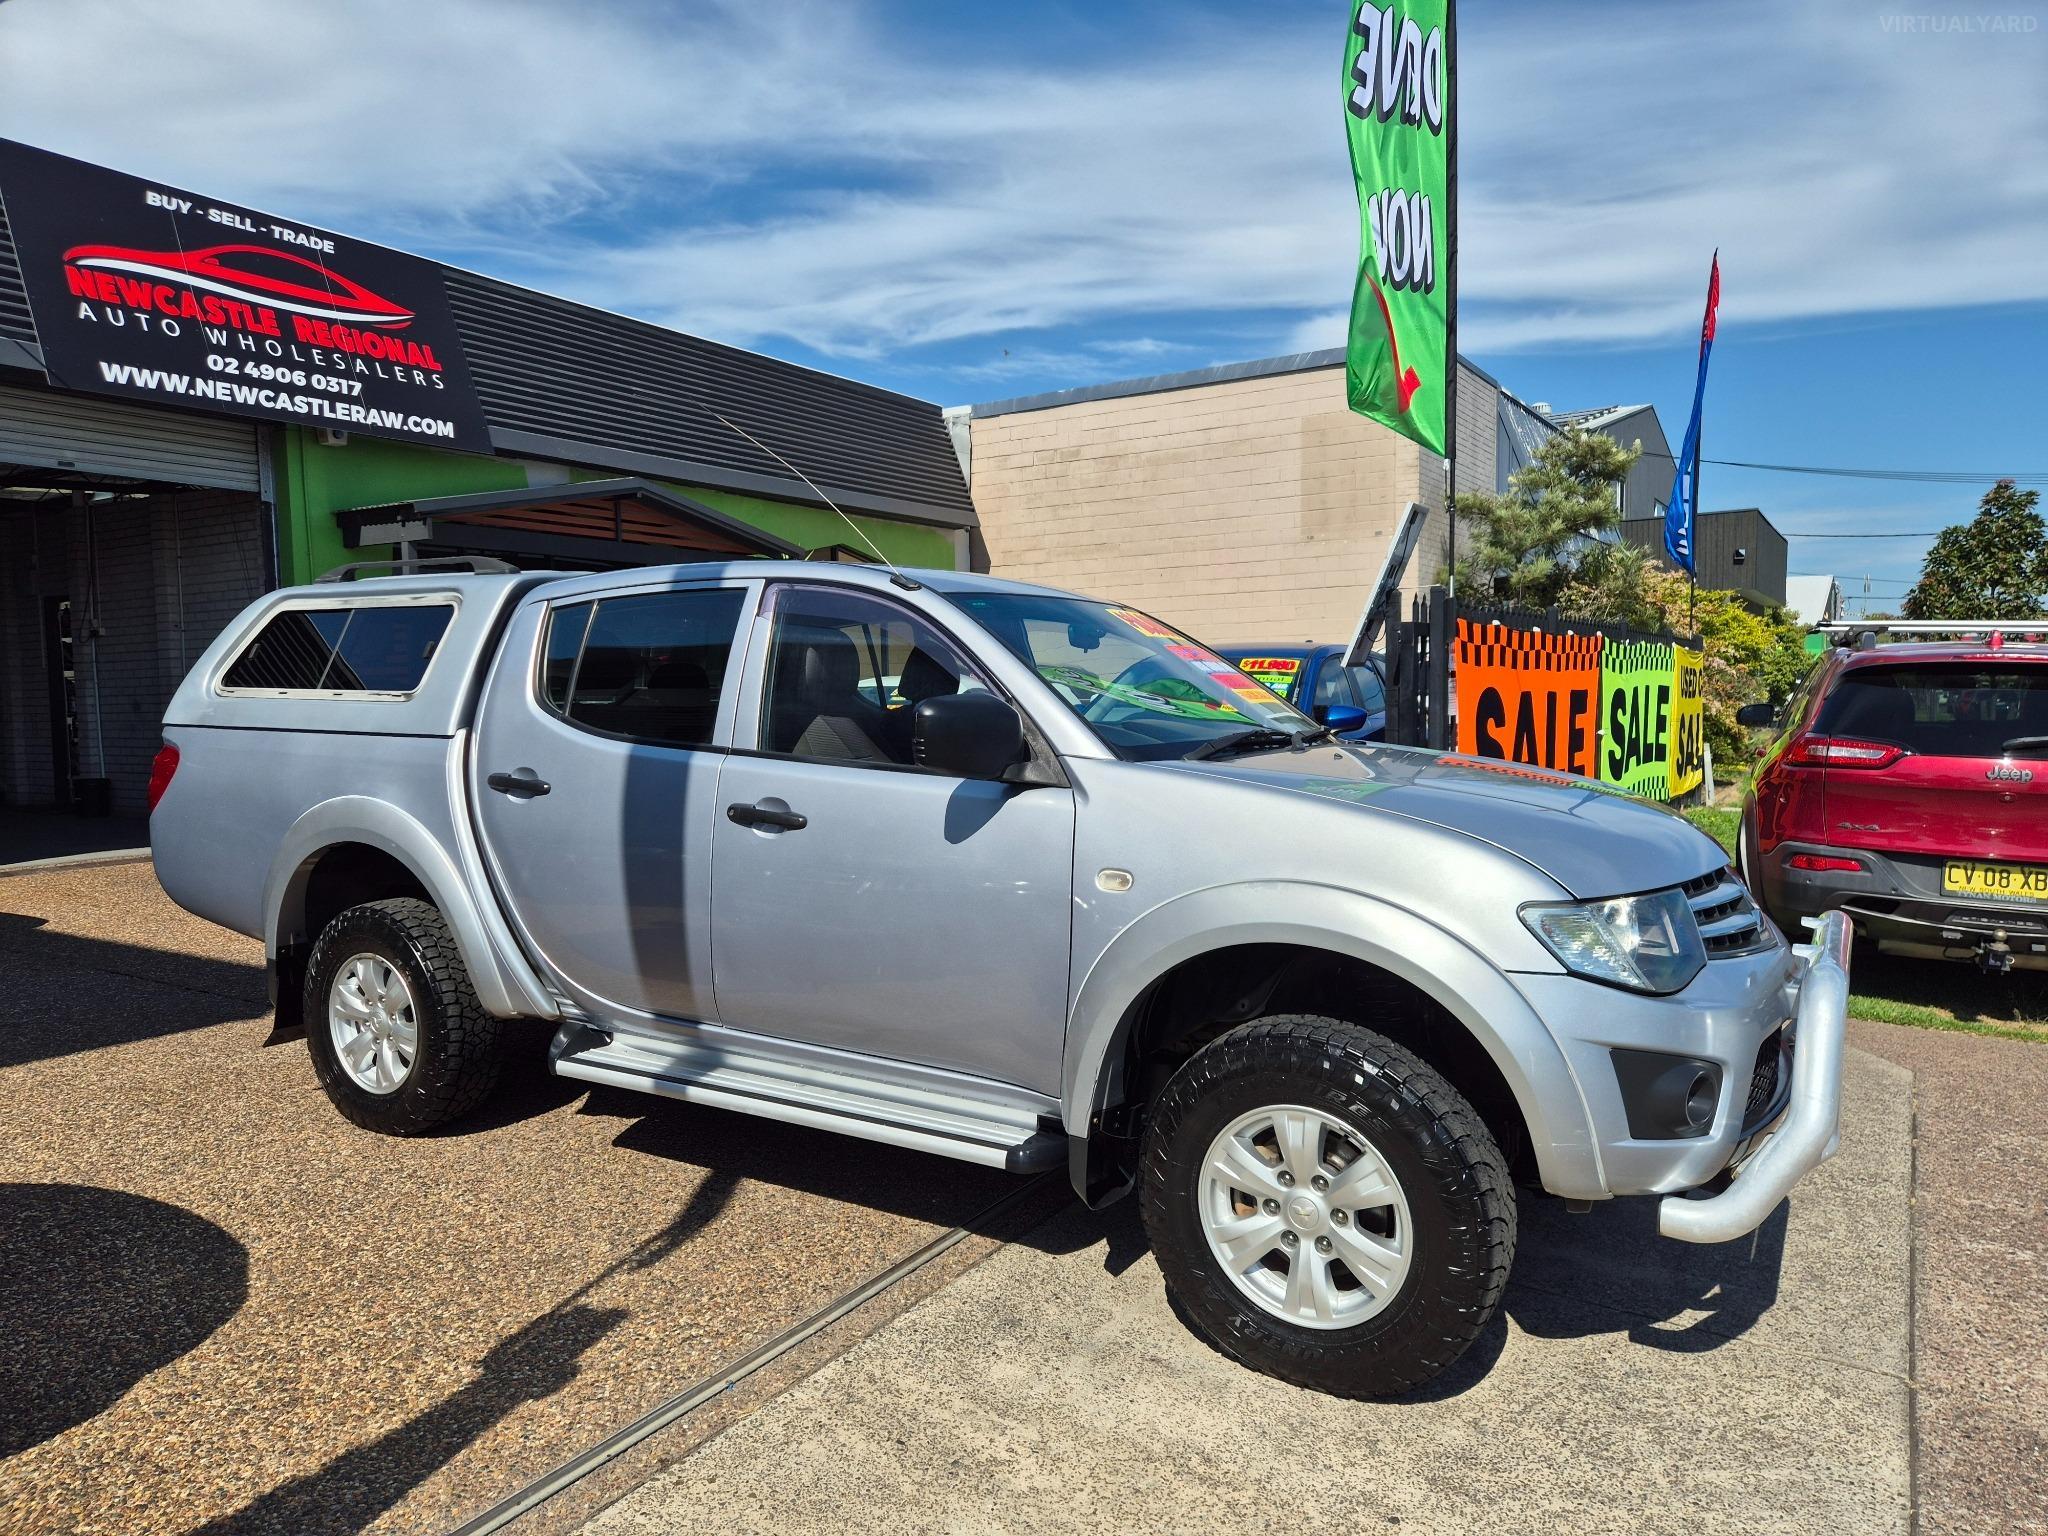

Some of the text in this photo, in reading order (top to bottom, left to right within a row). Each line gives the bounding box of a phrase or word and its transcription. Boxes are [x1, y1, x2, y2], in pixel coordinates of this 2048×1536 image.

[145, 190, 193, 215] BUY
[207, 208, 256, 233] SELL
[270, 224, 335, 254] TRADE
[63, 264, 443, 372] NEWCASTLE REGIONAL
[78, 301, 445, 390] AUTO WHOLESALERS
[99, 361, 455, 438] WWW.NEWCASTLERAW.COM
[206, 353, 363, 396] 02 4906 0317
[1680, 665, 1698, 699] USED
[1476, 686, 1589, 777] SALE
[1608, 684, 1670, 782] SALE
[1985, 765, 2034, 784] Jeep
[1979, 887, 2005, 896] SOUTH
[2008, 889, 2035, 898] WALES
